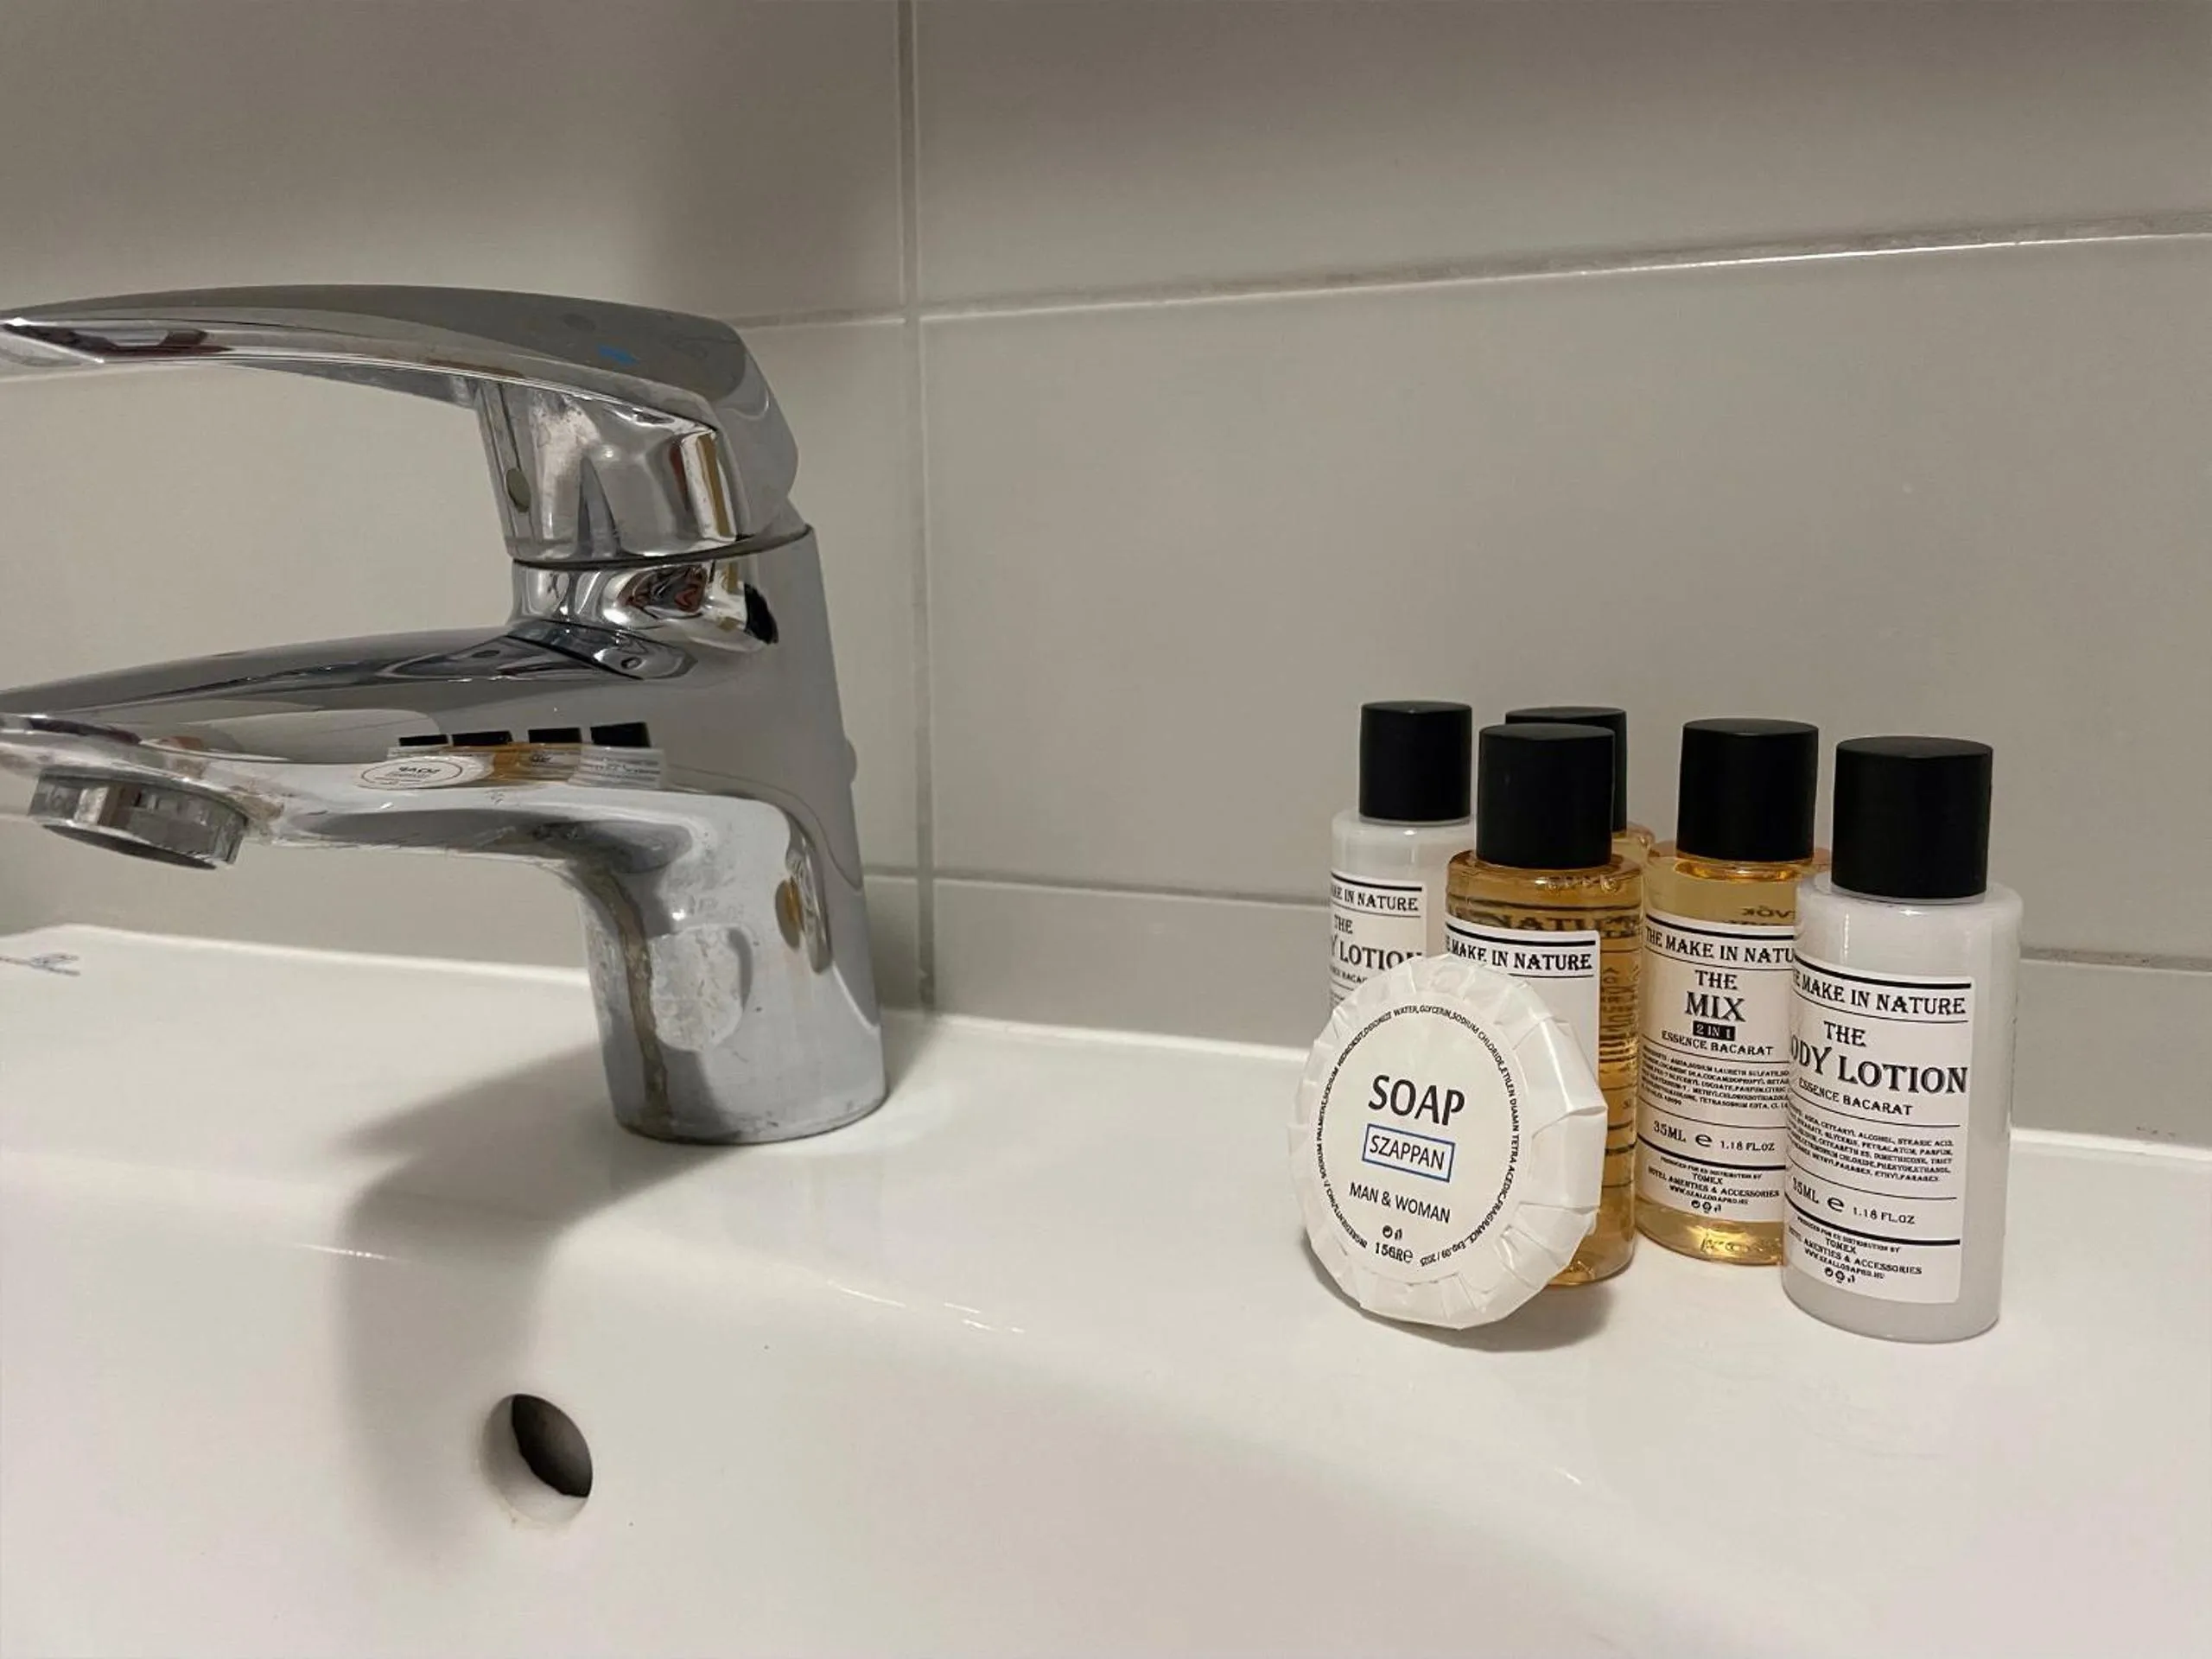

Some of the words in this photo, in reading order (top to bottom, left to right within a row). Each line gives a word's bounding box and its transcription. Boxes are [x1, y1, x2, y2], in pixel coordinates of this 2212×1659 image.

[1344, 888, 1355, 904] IN
[1357, 893, 1418, 911] NATURE
[1334, 914, 1353, 934] THE
[1340, 940, 1422, 970] LOTIO
[1646, 925, 1662, 948] THE
[1665, 934, 1714, 959] MAKE
[1719, 945, 1738, 961] IN
[1492, 950, 1508, 968] IN
[1514, 952, 1592, 971] NATURE
[1694, 969, 1738, 990] THE
[1685, 991, 1746, 1022] MIX
[1802, 975, 1846, 1003] MAKE
[1851, 989, 1870, 1009] IN
[1875, 994, 1966, 1015] NATURE
[1661, 1031, 1707, 1051] ESSENCE
[1711, 1042, 1774, 1056] BACARAT
[1696, 1024, 1705, 1035] 2
[1707, 1026, 1719, 1037] IN
[1726, 1027, 1732, 1039] 1
[1824, 1020, 1866, 1047] THE
[1838, 1055, 1968, 1095] LOTION
[1368, 1074, 1465, 1126] SOAP
[1799, 1077, 1840, 1103] ESSENCE
[1843, 1095, 1914, 1116] BACARAT
[1653, 1120, 1687, 1143] 35ML
[1720, 1141, 1743, 1152] 1.18
[1745, 1142, 1775, 1152] FL.OZ
[1316, 1143, 1326, 1179] SODIUM
[1510, 1134, 1519, 1163] TETRA
[1370, 1135, 1445, 1170] SZAPPAN
[1691, 1173, 1723, 1185] TOMEX
[1720, 1187, 1779, 1198] ACCESSORIES
[1349, 1181, 1379, 1203] MAN
[1381, 1191, 1391, 1207] &
[1395, 1194, 1451, 1224] WOMAN
[1853, 1207, 1878, 1220] 1.18
[1880, 1211, 1916, 1225] FL.OZ
[1826, 1236, 1857, 1254] TOMEX
[1854, 1257, 1923, 1274] ACCESSORIES
